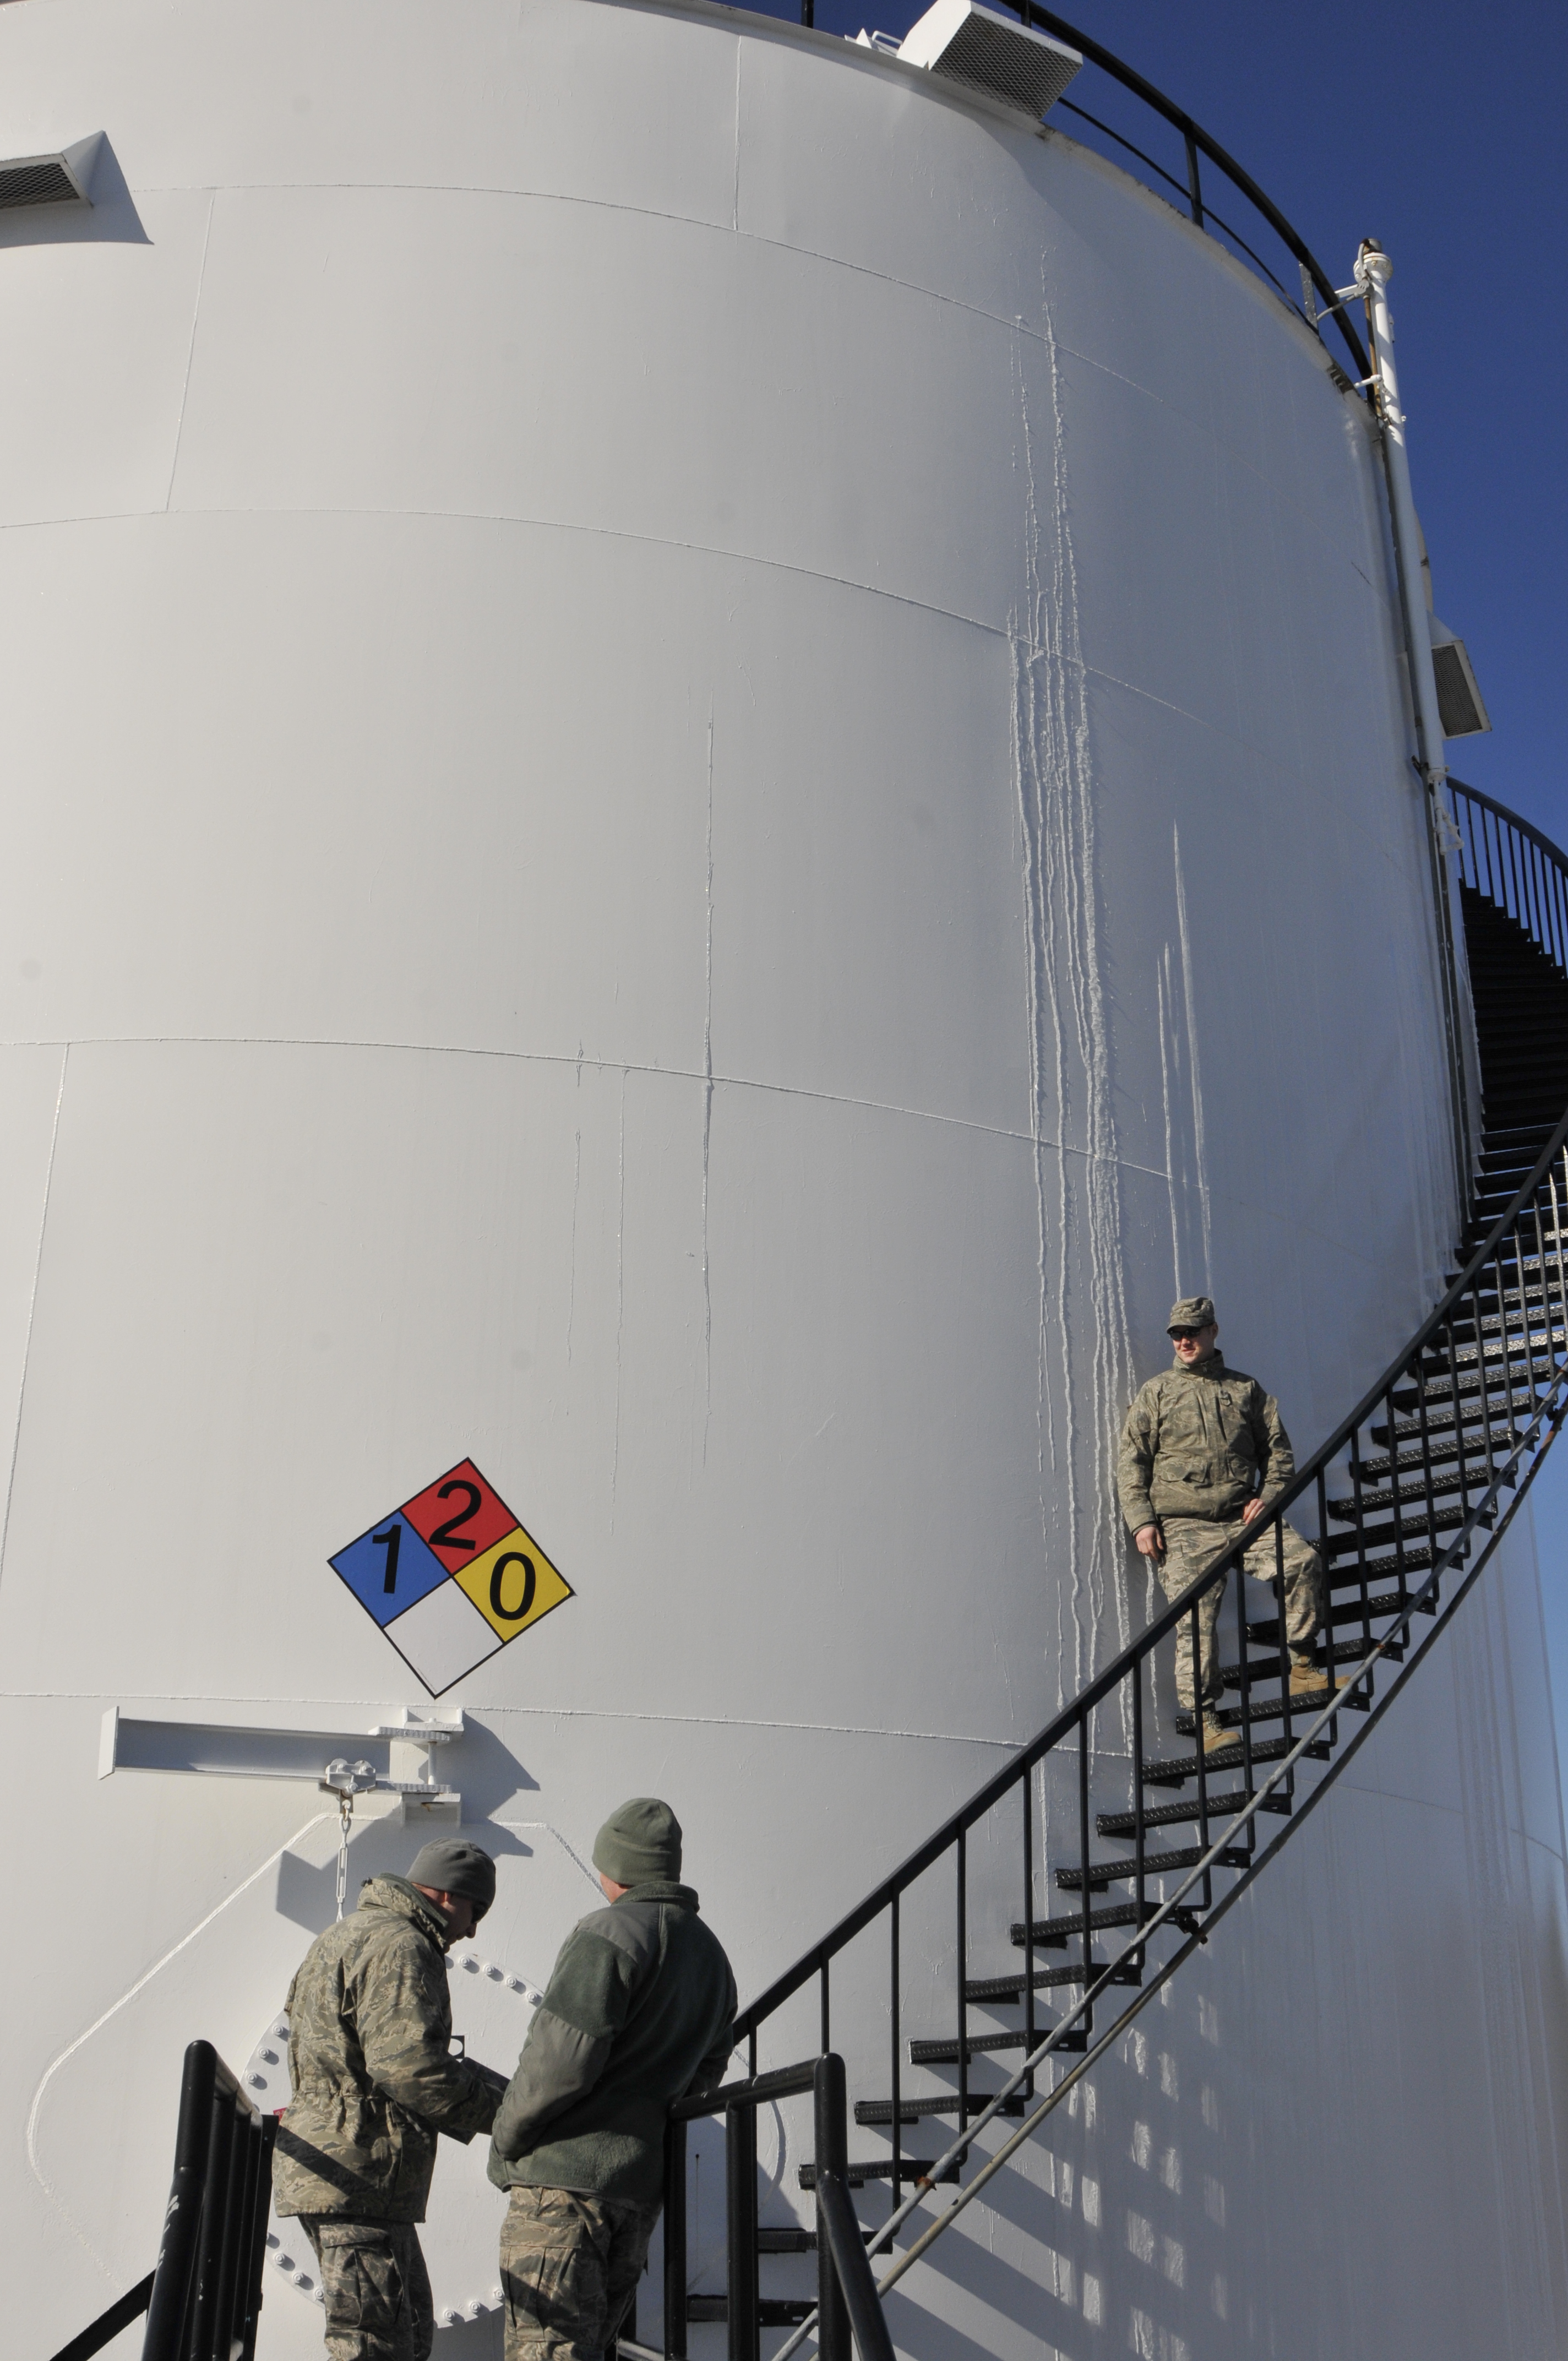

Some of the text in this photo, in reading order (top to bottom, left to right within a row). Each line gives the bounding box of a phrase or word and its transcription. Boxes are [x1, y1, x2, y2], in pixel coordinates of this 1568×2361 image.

[428, 1479, 482, 1551] 2
[372, 1525, 402, 1594] 1
[489, 1552, 536, 1620] 0
